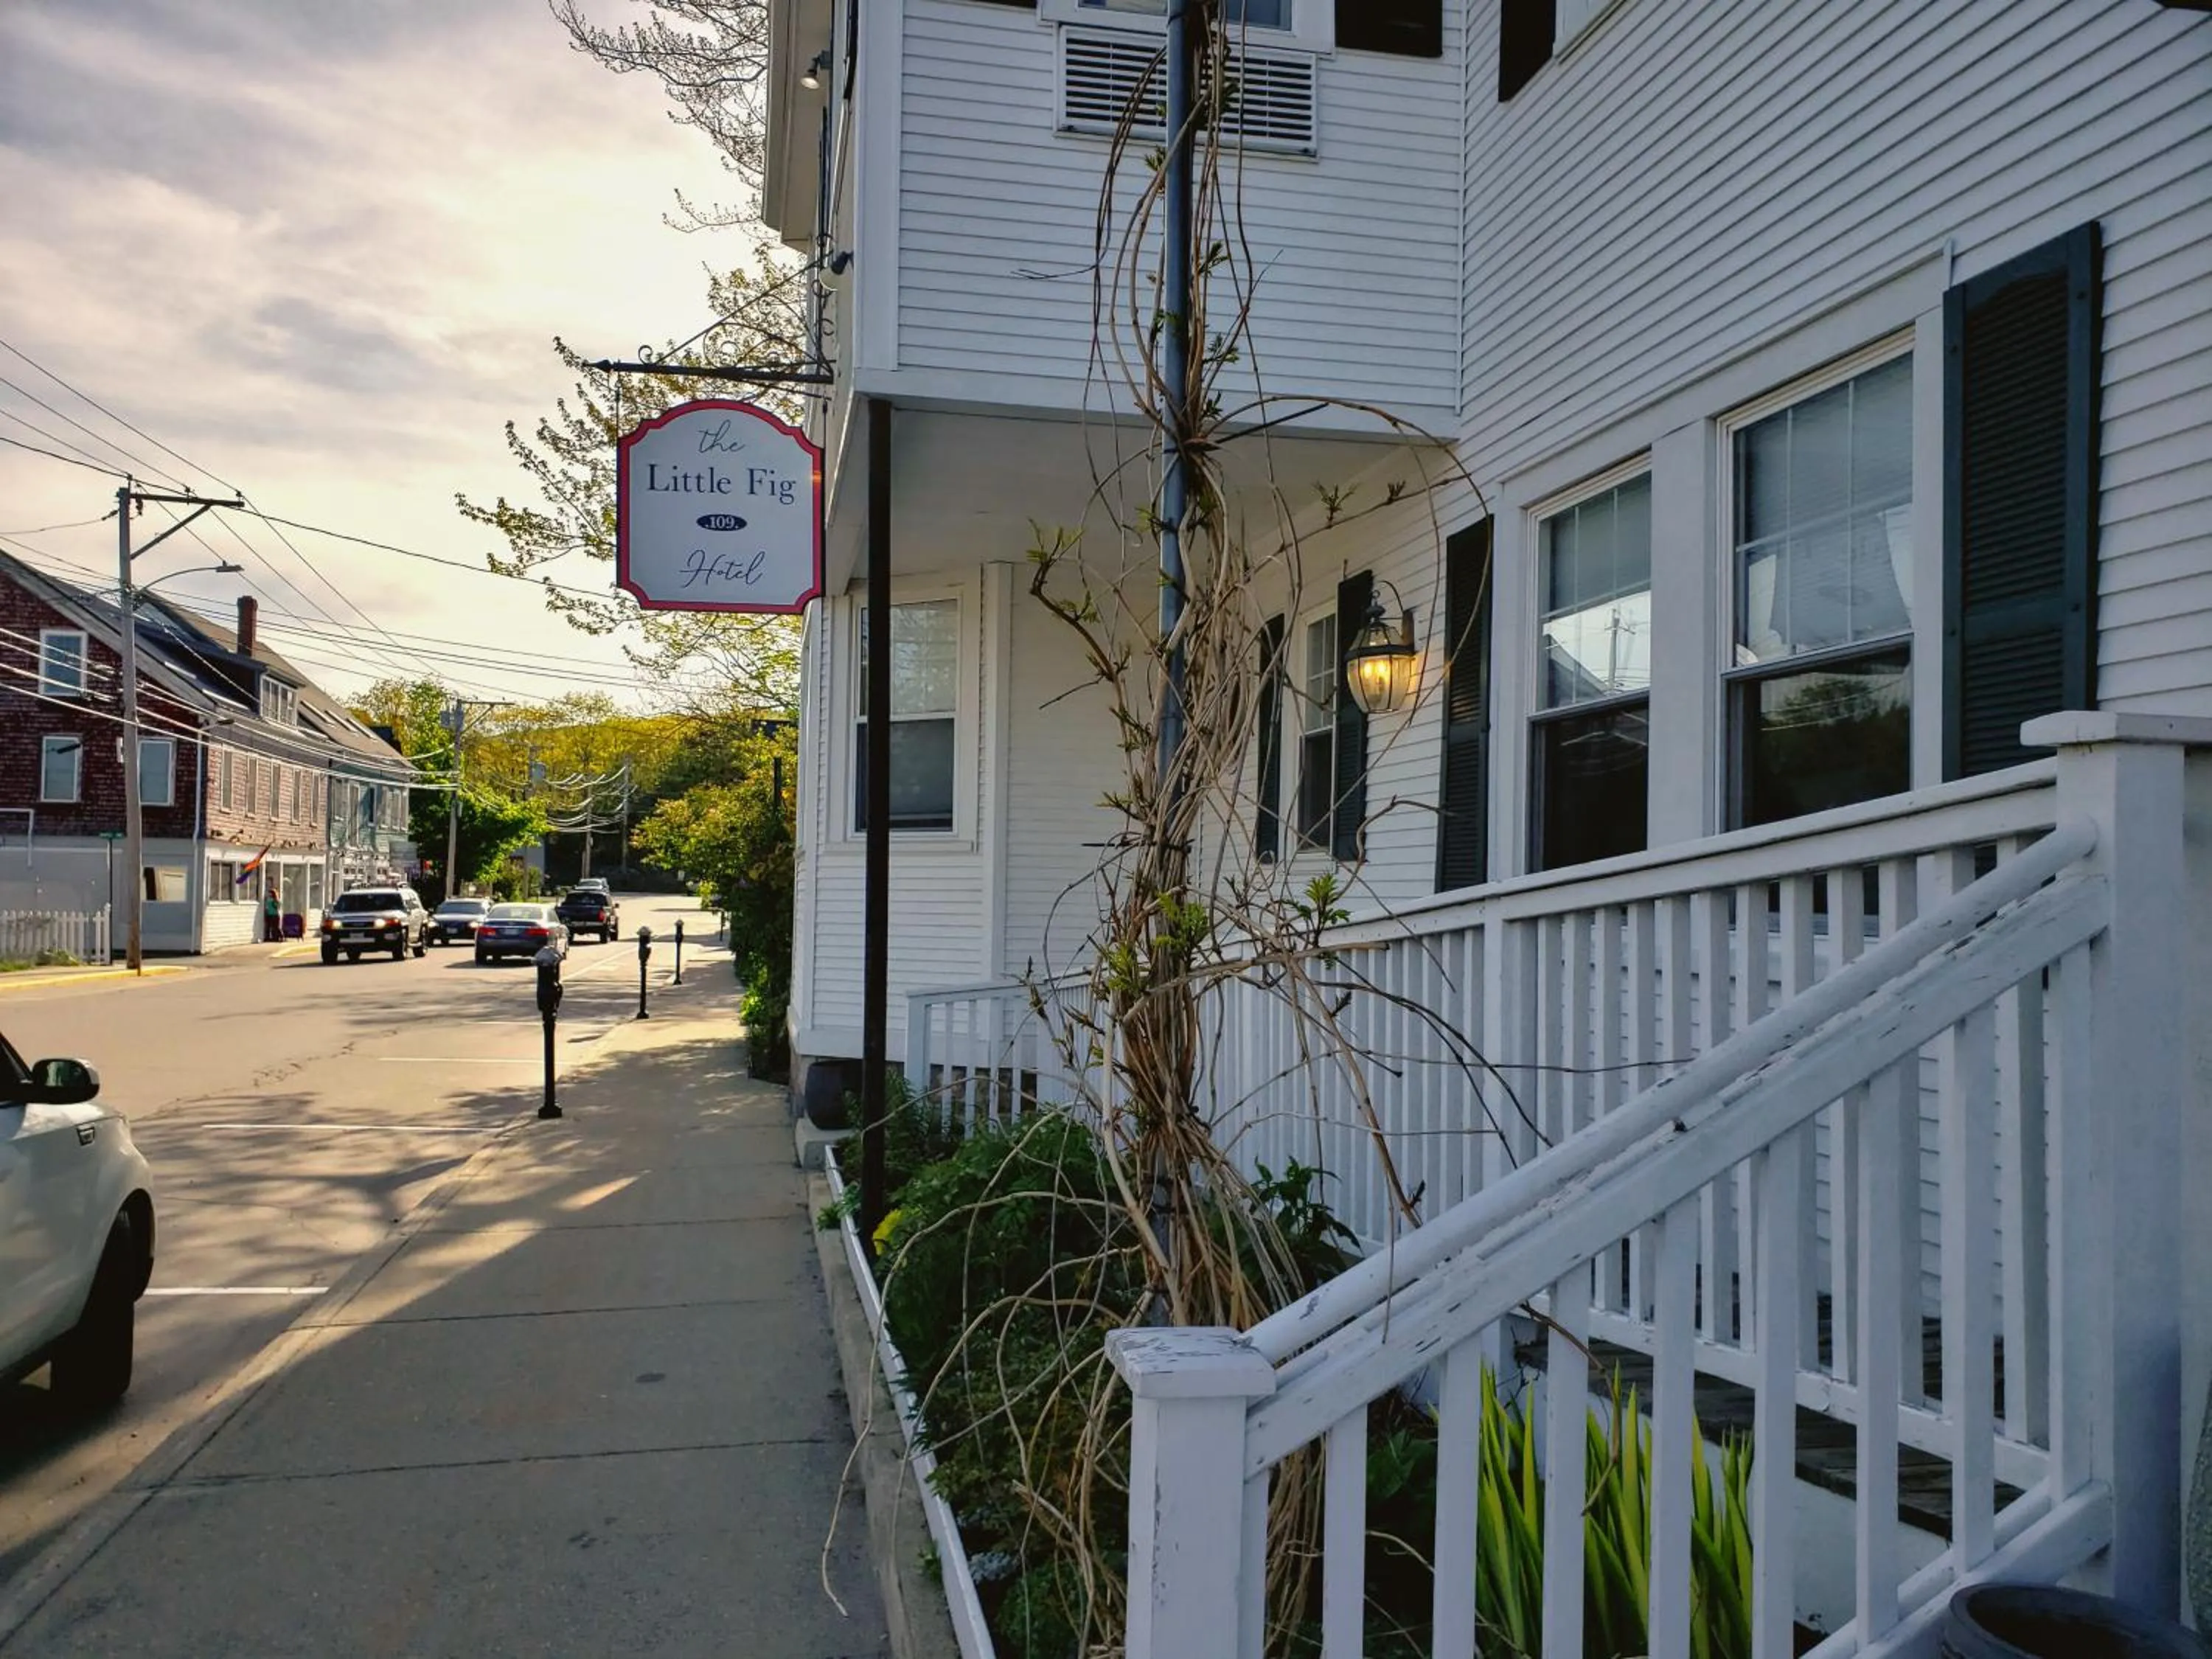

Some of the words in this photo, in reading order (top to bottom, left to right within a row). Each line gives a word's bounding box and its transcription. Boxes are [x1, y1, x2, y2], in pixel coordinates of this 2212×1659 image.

[698, 420, 747, 453] the
[647, 464, 731, 495] Little
[747, 467, 796, 505] Fig
[679, 549, 765, 588] Hotel
